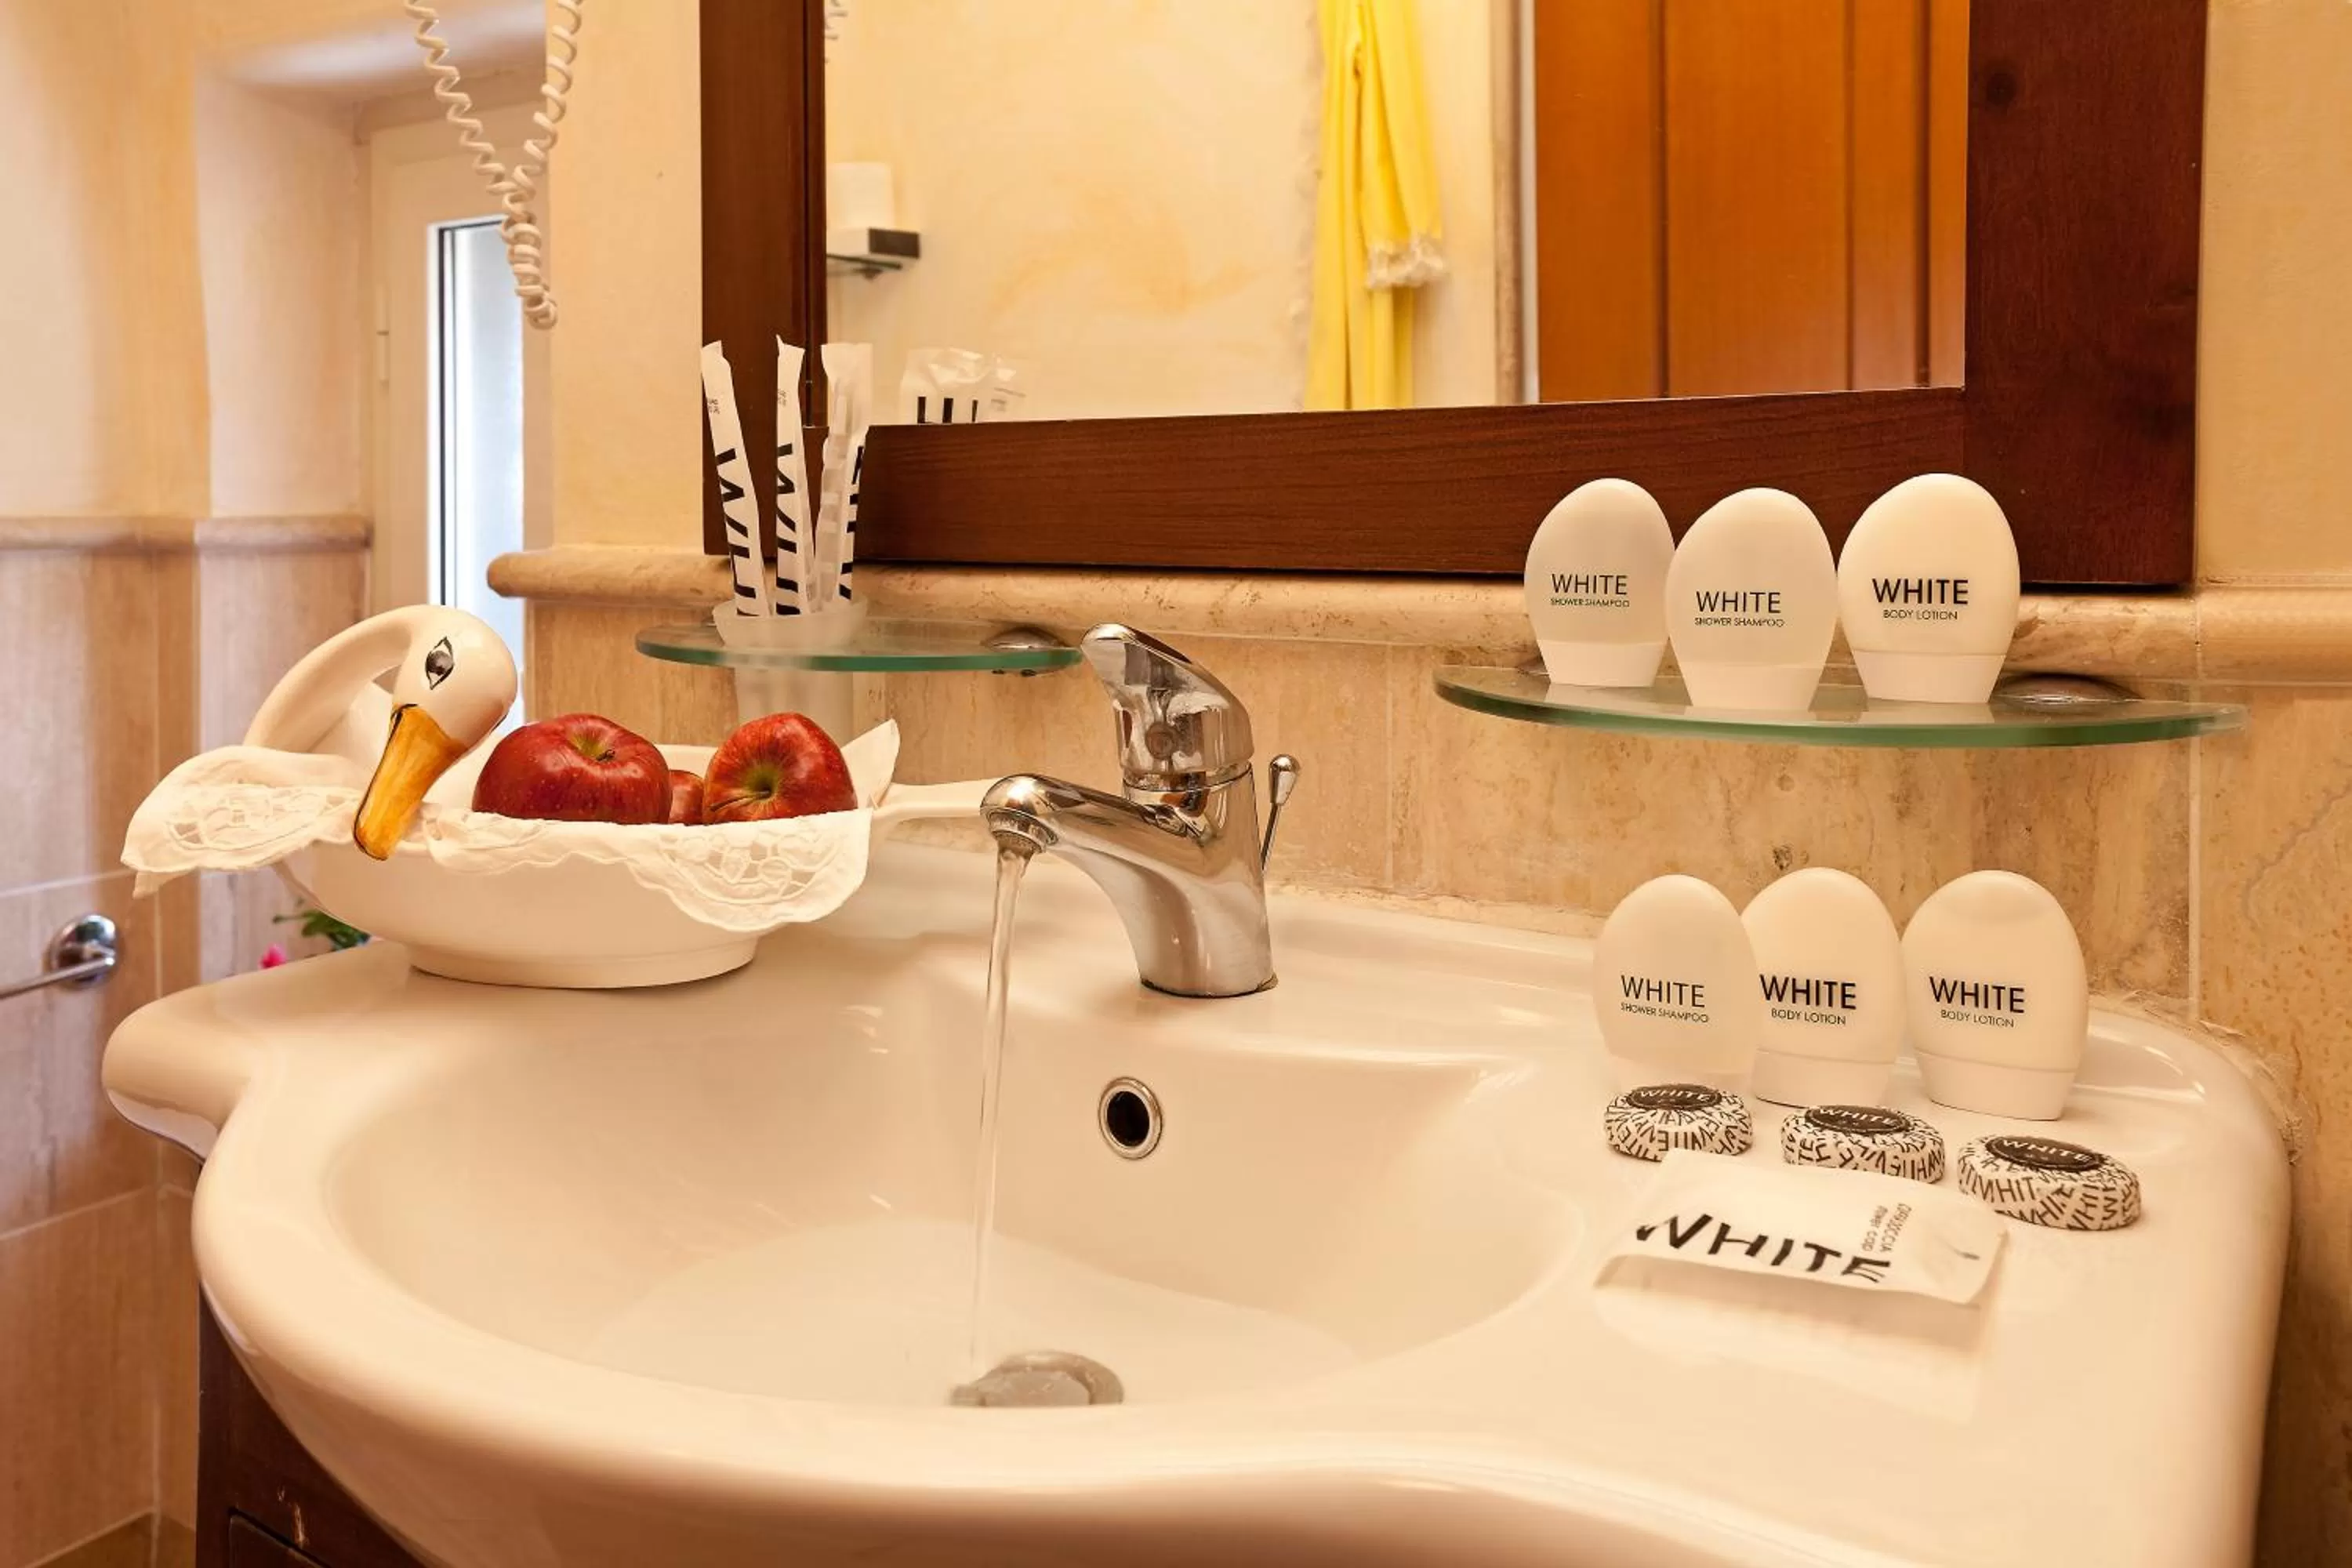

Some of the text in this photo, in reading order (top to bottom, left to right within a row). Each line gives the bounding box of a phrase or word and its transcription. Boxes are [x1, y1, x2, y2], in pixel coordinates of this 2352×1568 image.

[1552, 573, 1628, 595] WHITE
[1871, 578, 1969, 604] WHITE
[1550, 597, 1630, 608] SHOWER SHAMPOO
[1696, 590, 1781, 614] WHITE
[1694, 617, 1785, 628] SHOWER SHAMPOO
[1883, 609, 1958, 620] BODY LOTION
[1621, 975, 1705, 1008] WHITE
[1759, 974, 1857, 1010] WHITE
[1929, 976, 2024, 1014] WHITE
[1621, 1003, 1709, 1023] SHOWER SHAMPOO
[1771, 1007, 1846, 1025] BODY LOTION
[1940, 1009, 2014, 1028] BODY LOTION
[1640, 1089, 1712, 1102] WHITE
[1819, 1109, 1899, 1127] WHITE
[2002, 1138, 2093, 1163] WHITE
[1636, 1213, 1891, 1283] WHITE
